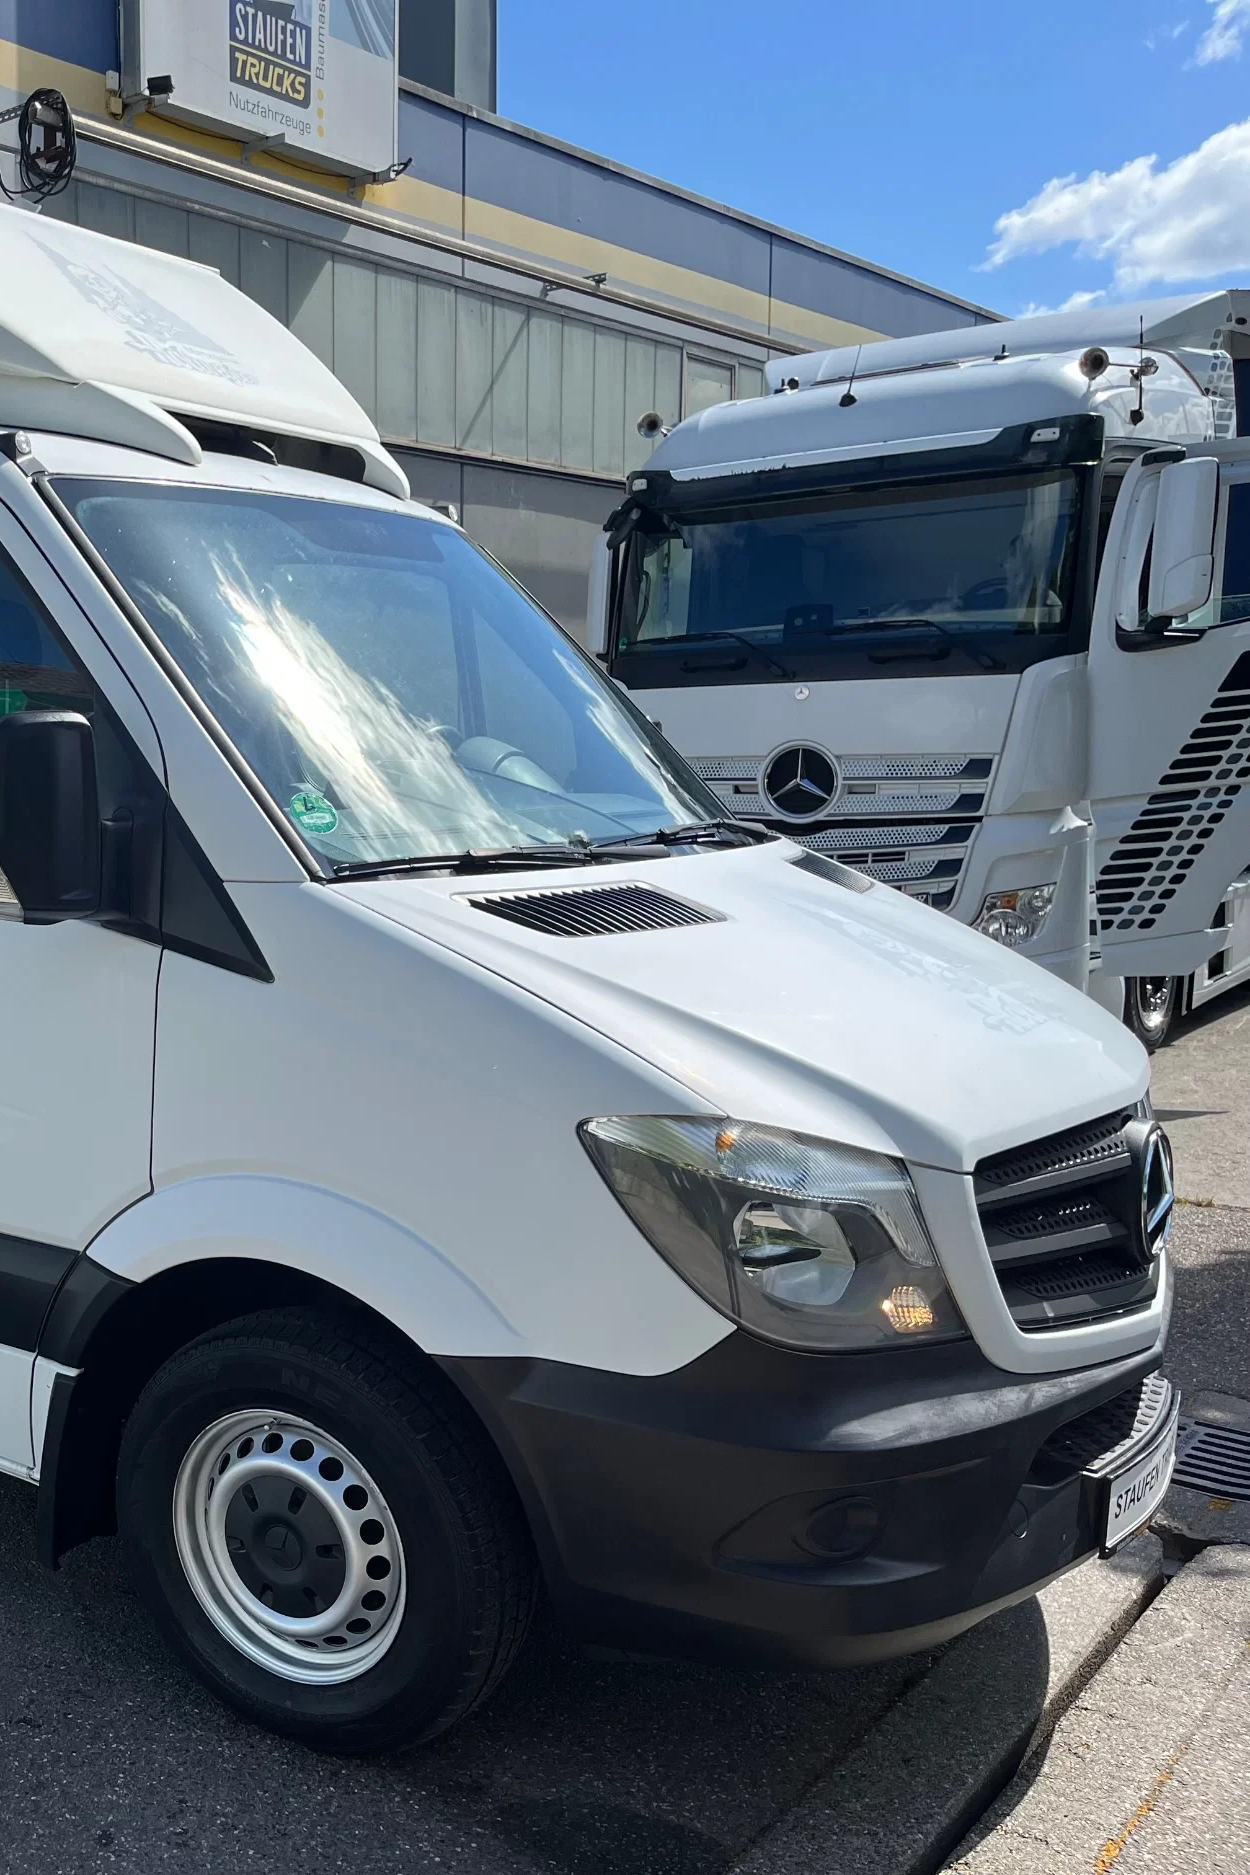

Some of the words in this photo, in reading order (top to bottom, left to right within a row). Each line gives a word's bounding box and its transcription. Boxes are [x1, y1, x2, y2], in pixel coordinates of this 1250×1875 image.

[235, 2, 306, 65] STAUFEN
[315, 0, 326, 80] Baumas
[234, 51, 306, 101] TRUCKS
[229, 90, 311, 136] Nutzfahrzeuge
[1114, 1462, 1159, 1519] STAUFEN
